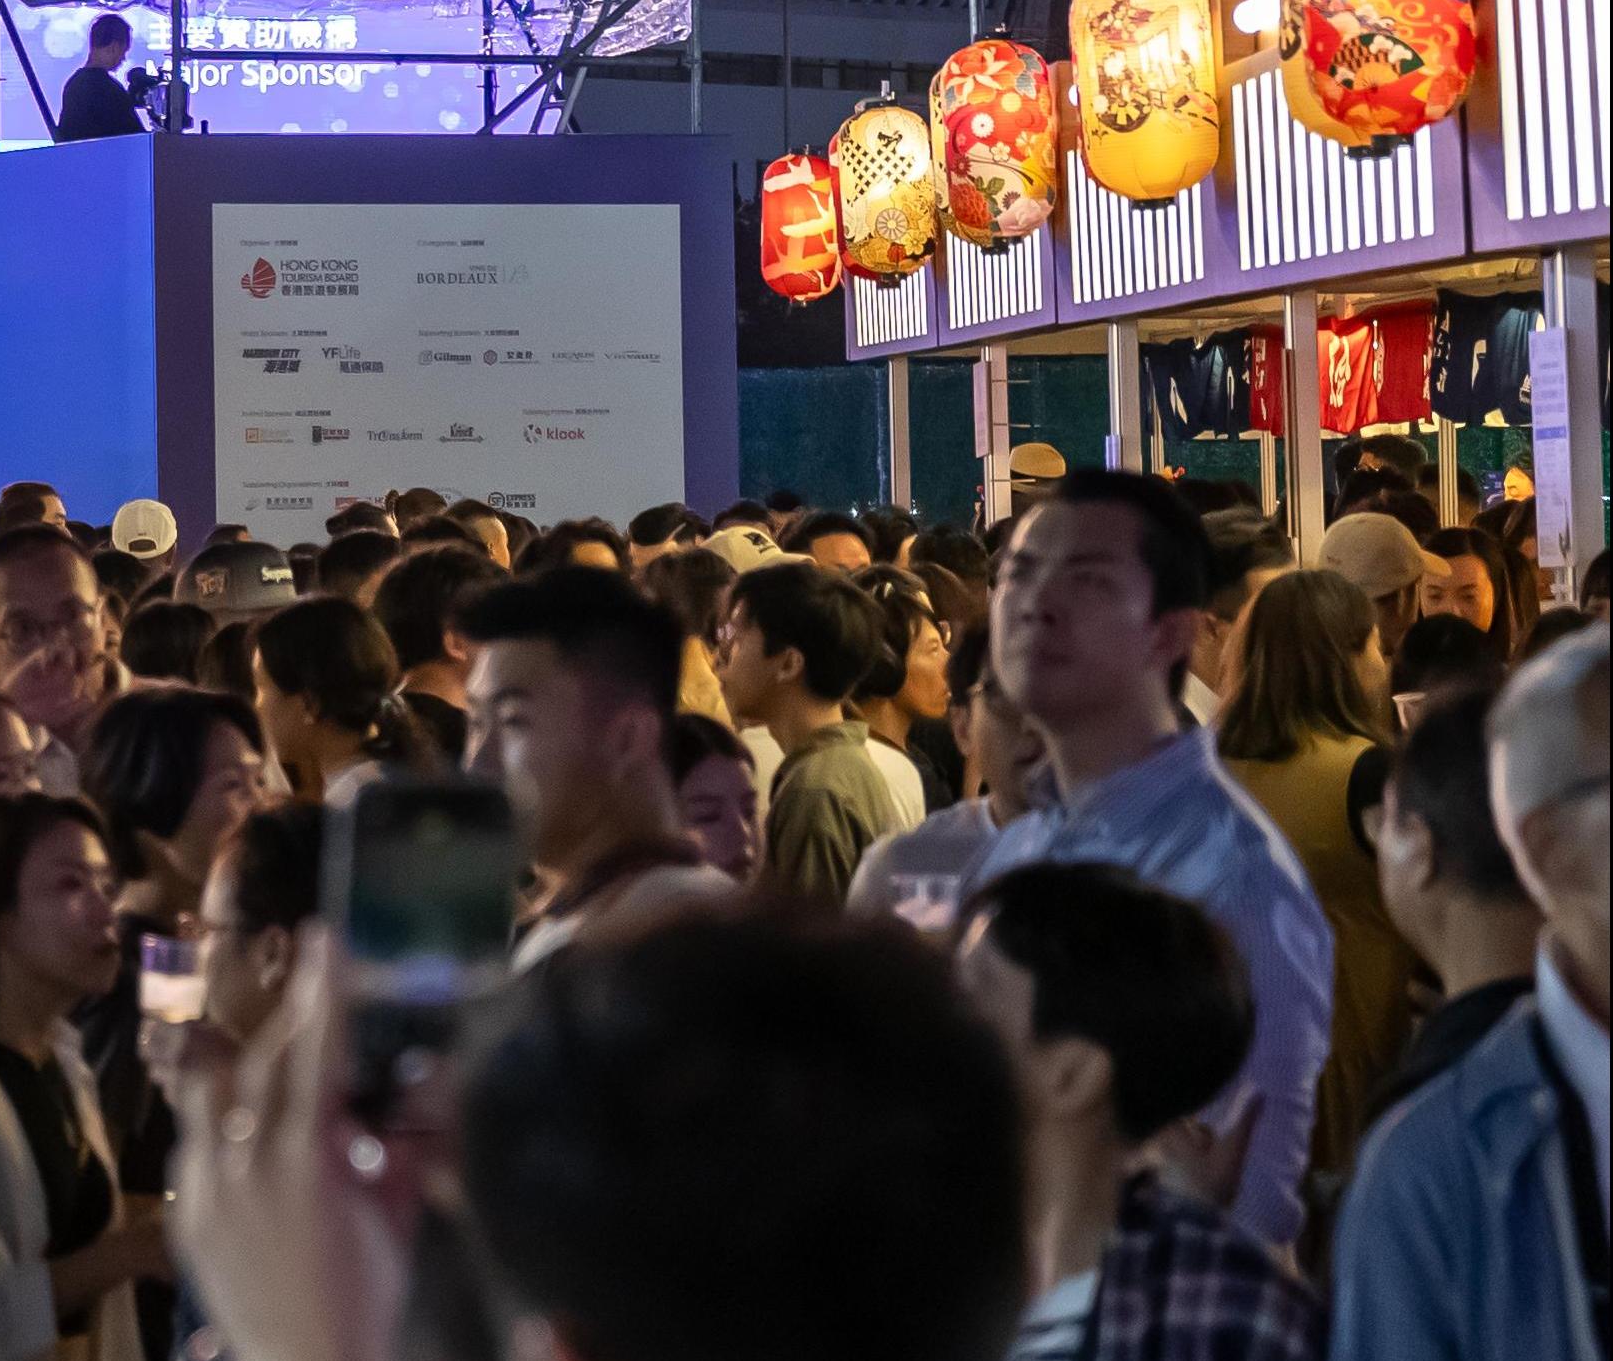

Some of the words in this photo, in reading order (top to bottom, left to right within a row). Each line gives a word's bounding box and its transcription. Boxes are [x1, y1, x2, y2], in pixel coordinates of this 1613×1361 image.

[241, 59, 364, 93] Sponsor
[280, 260, 319, 271] HONG
[321, 260, 358, 271] KONG
[281, 273, 322, 282] TOURISM
[325, 273, 359, 282] BOARD
[417, 272, 497, 284] BORDEAUX
[433, 352, 471, 361] Gilman
[546, 427, 585, 440] klook
